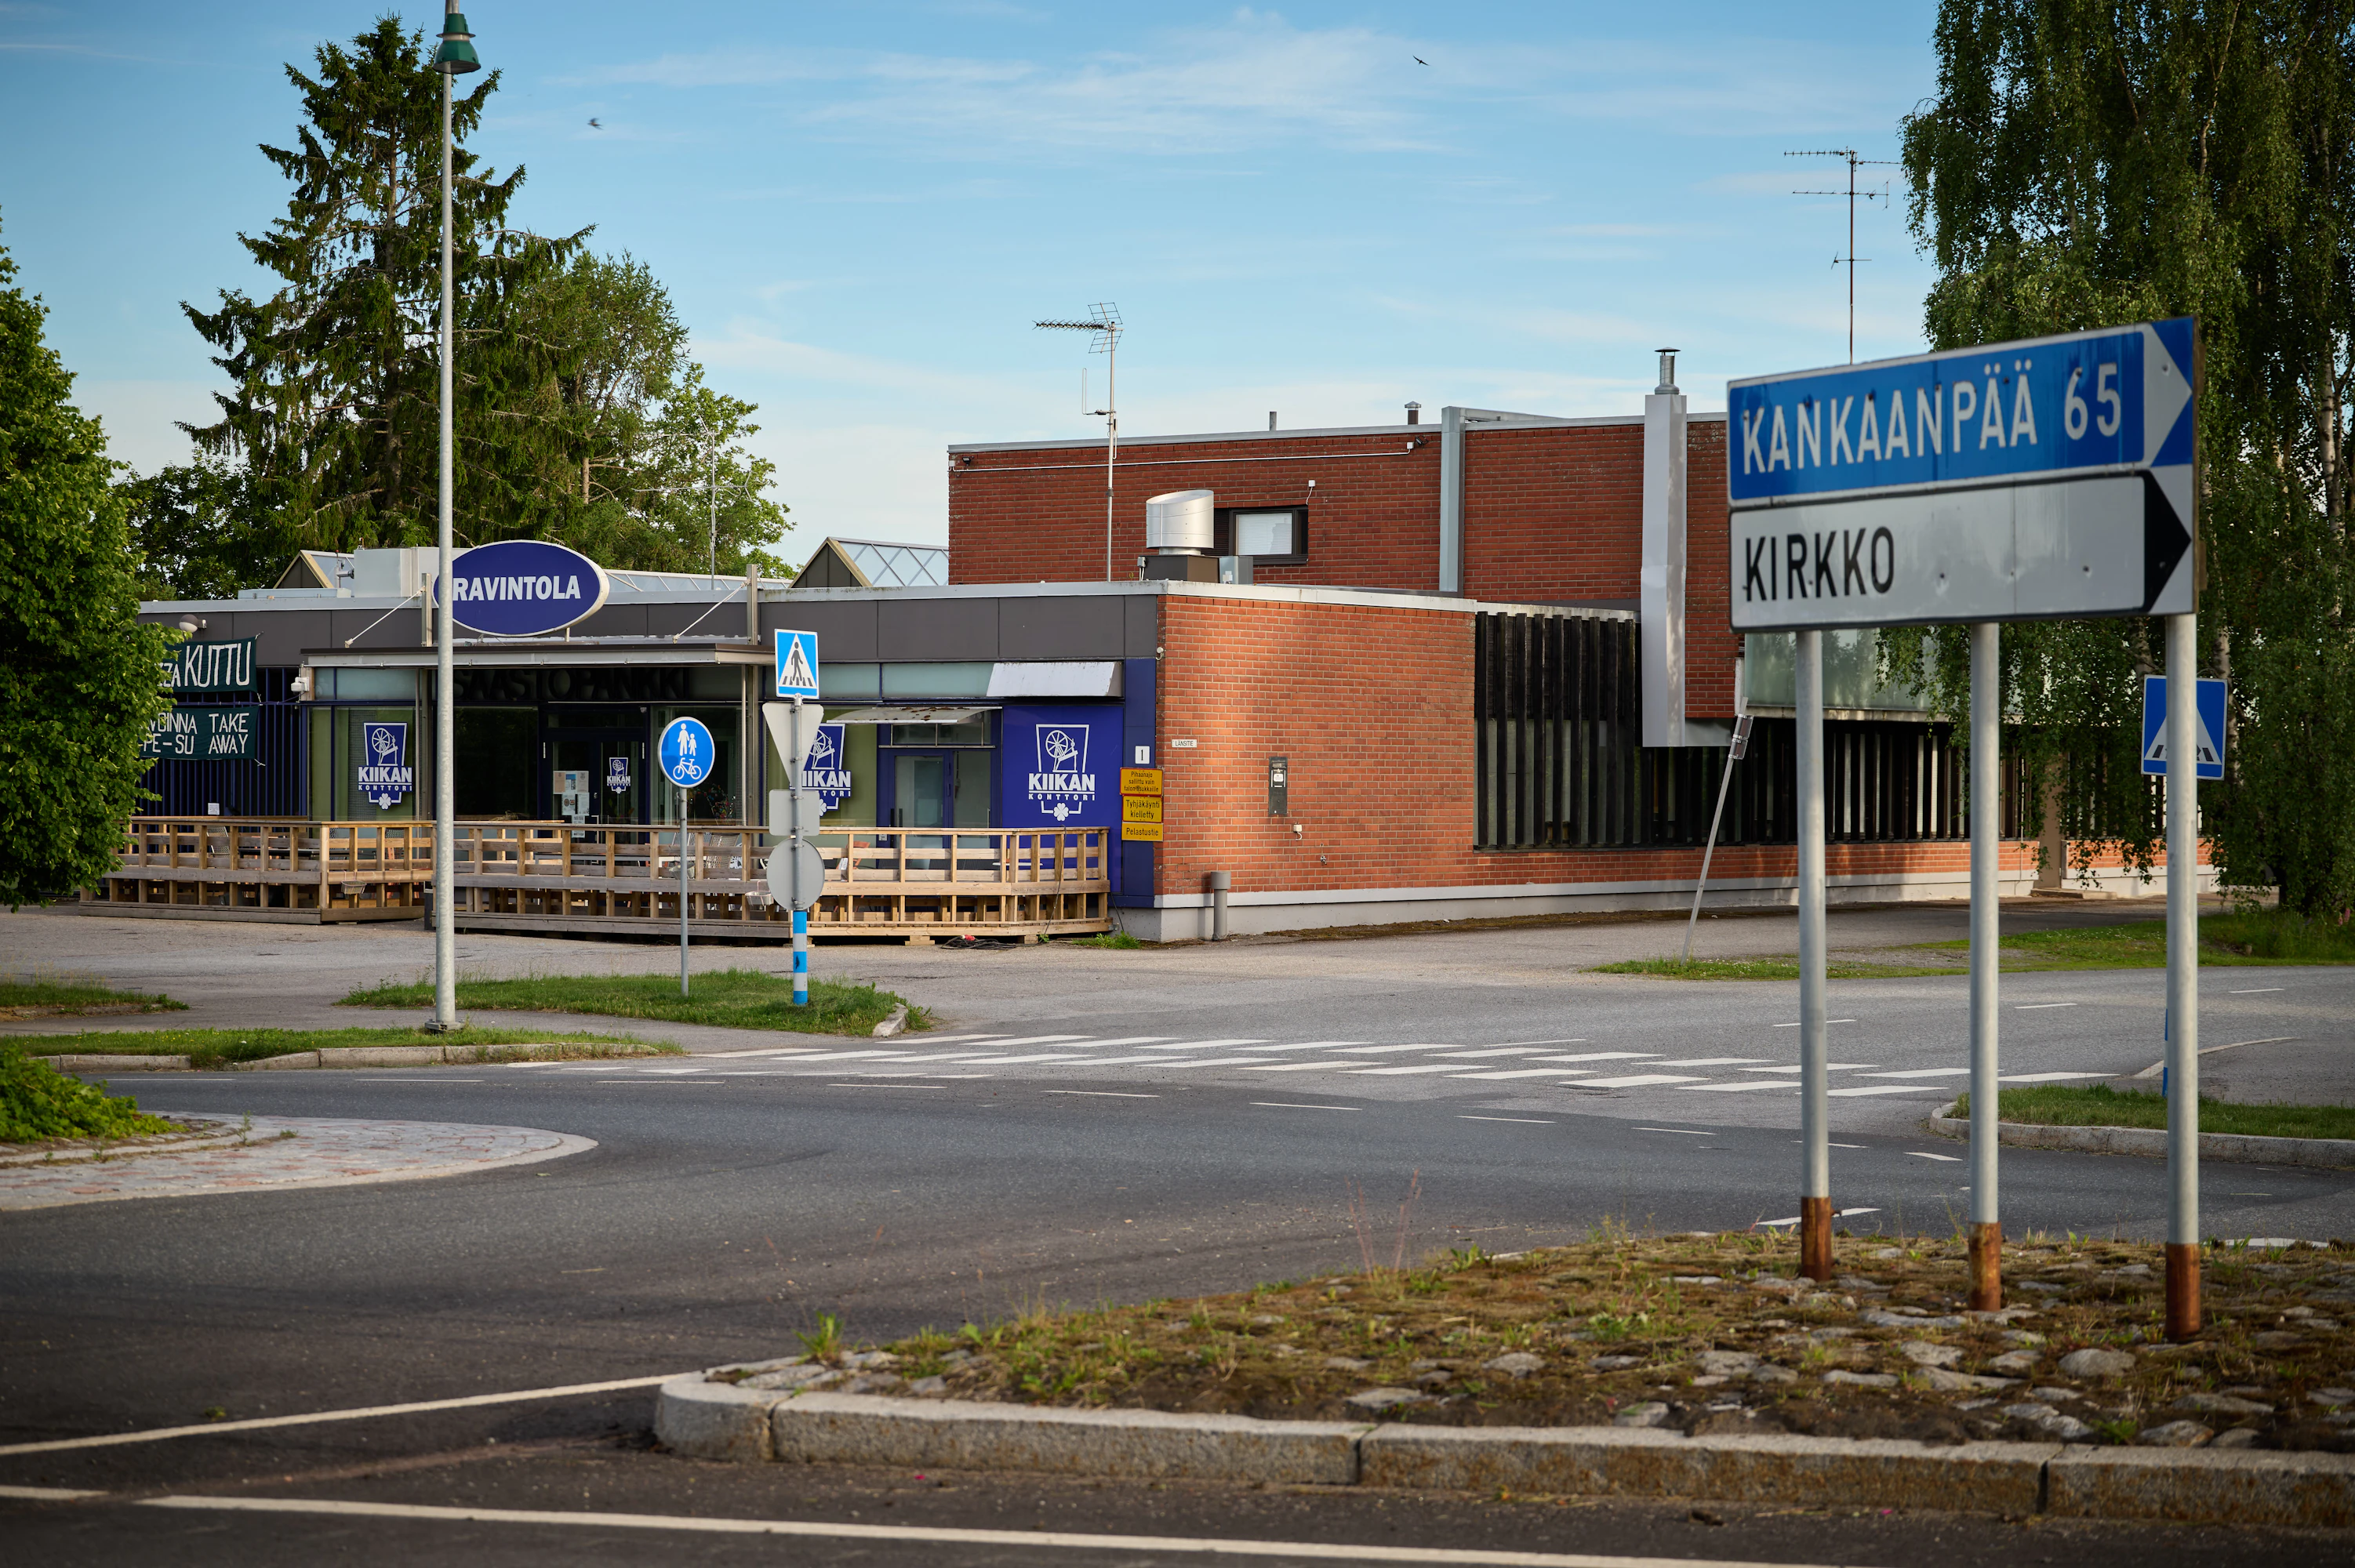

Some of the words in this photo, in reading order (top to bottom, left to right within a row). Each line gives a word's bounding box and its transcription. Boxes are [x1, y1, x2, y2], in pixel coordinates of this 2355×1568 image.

[1743, 358, 2038, 475] KANKAANPÄÄ
[2064, 362, 2122, 441] 65
[1745, 526, 1895, 602] KIRKKO
[452, 575, 581, 601] RAVINTOLA
[184, 641, 252, 688] KUTTU
[147, 712, 198, 735] VOINNA
[209, 713, 249, 733] TAKE
[208, 734, 249, 754] AWAY
[1140, 749, 1144, 761] 1
[358, 767, 412, 782] KIIKAN
[801, 771, 851, 787] IIKAN
[1028, 773, 1096, 791] KIIKAN
[1126, 800, 1160, 809] Tyhjäkäynti
[1130, 811, 1154, 819] kielletty
[1126, 827, 1159, 837] Pelastustie
